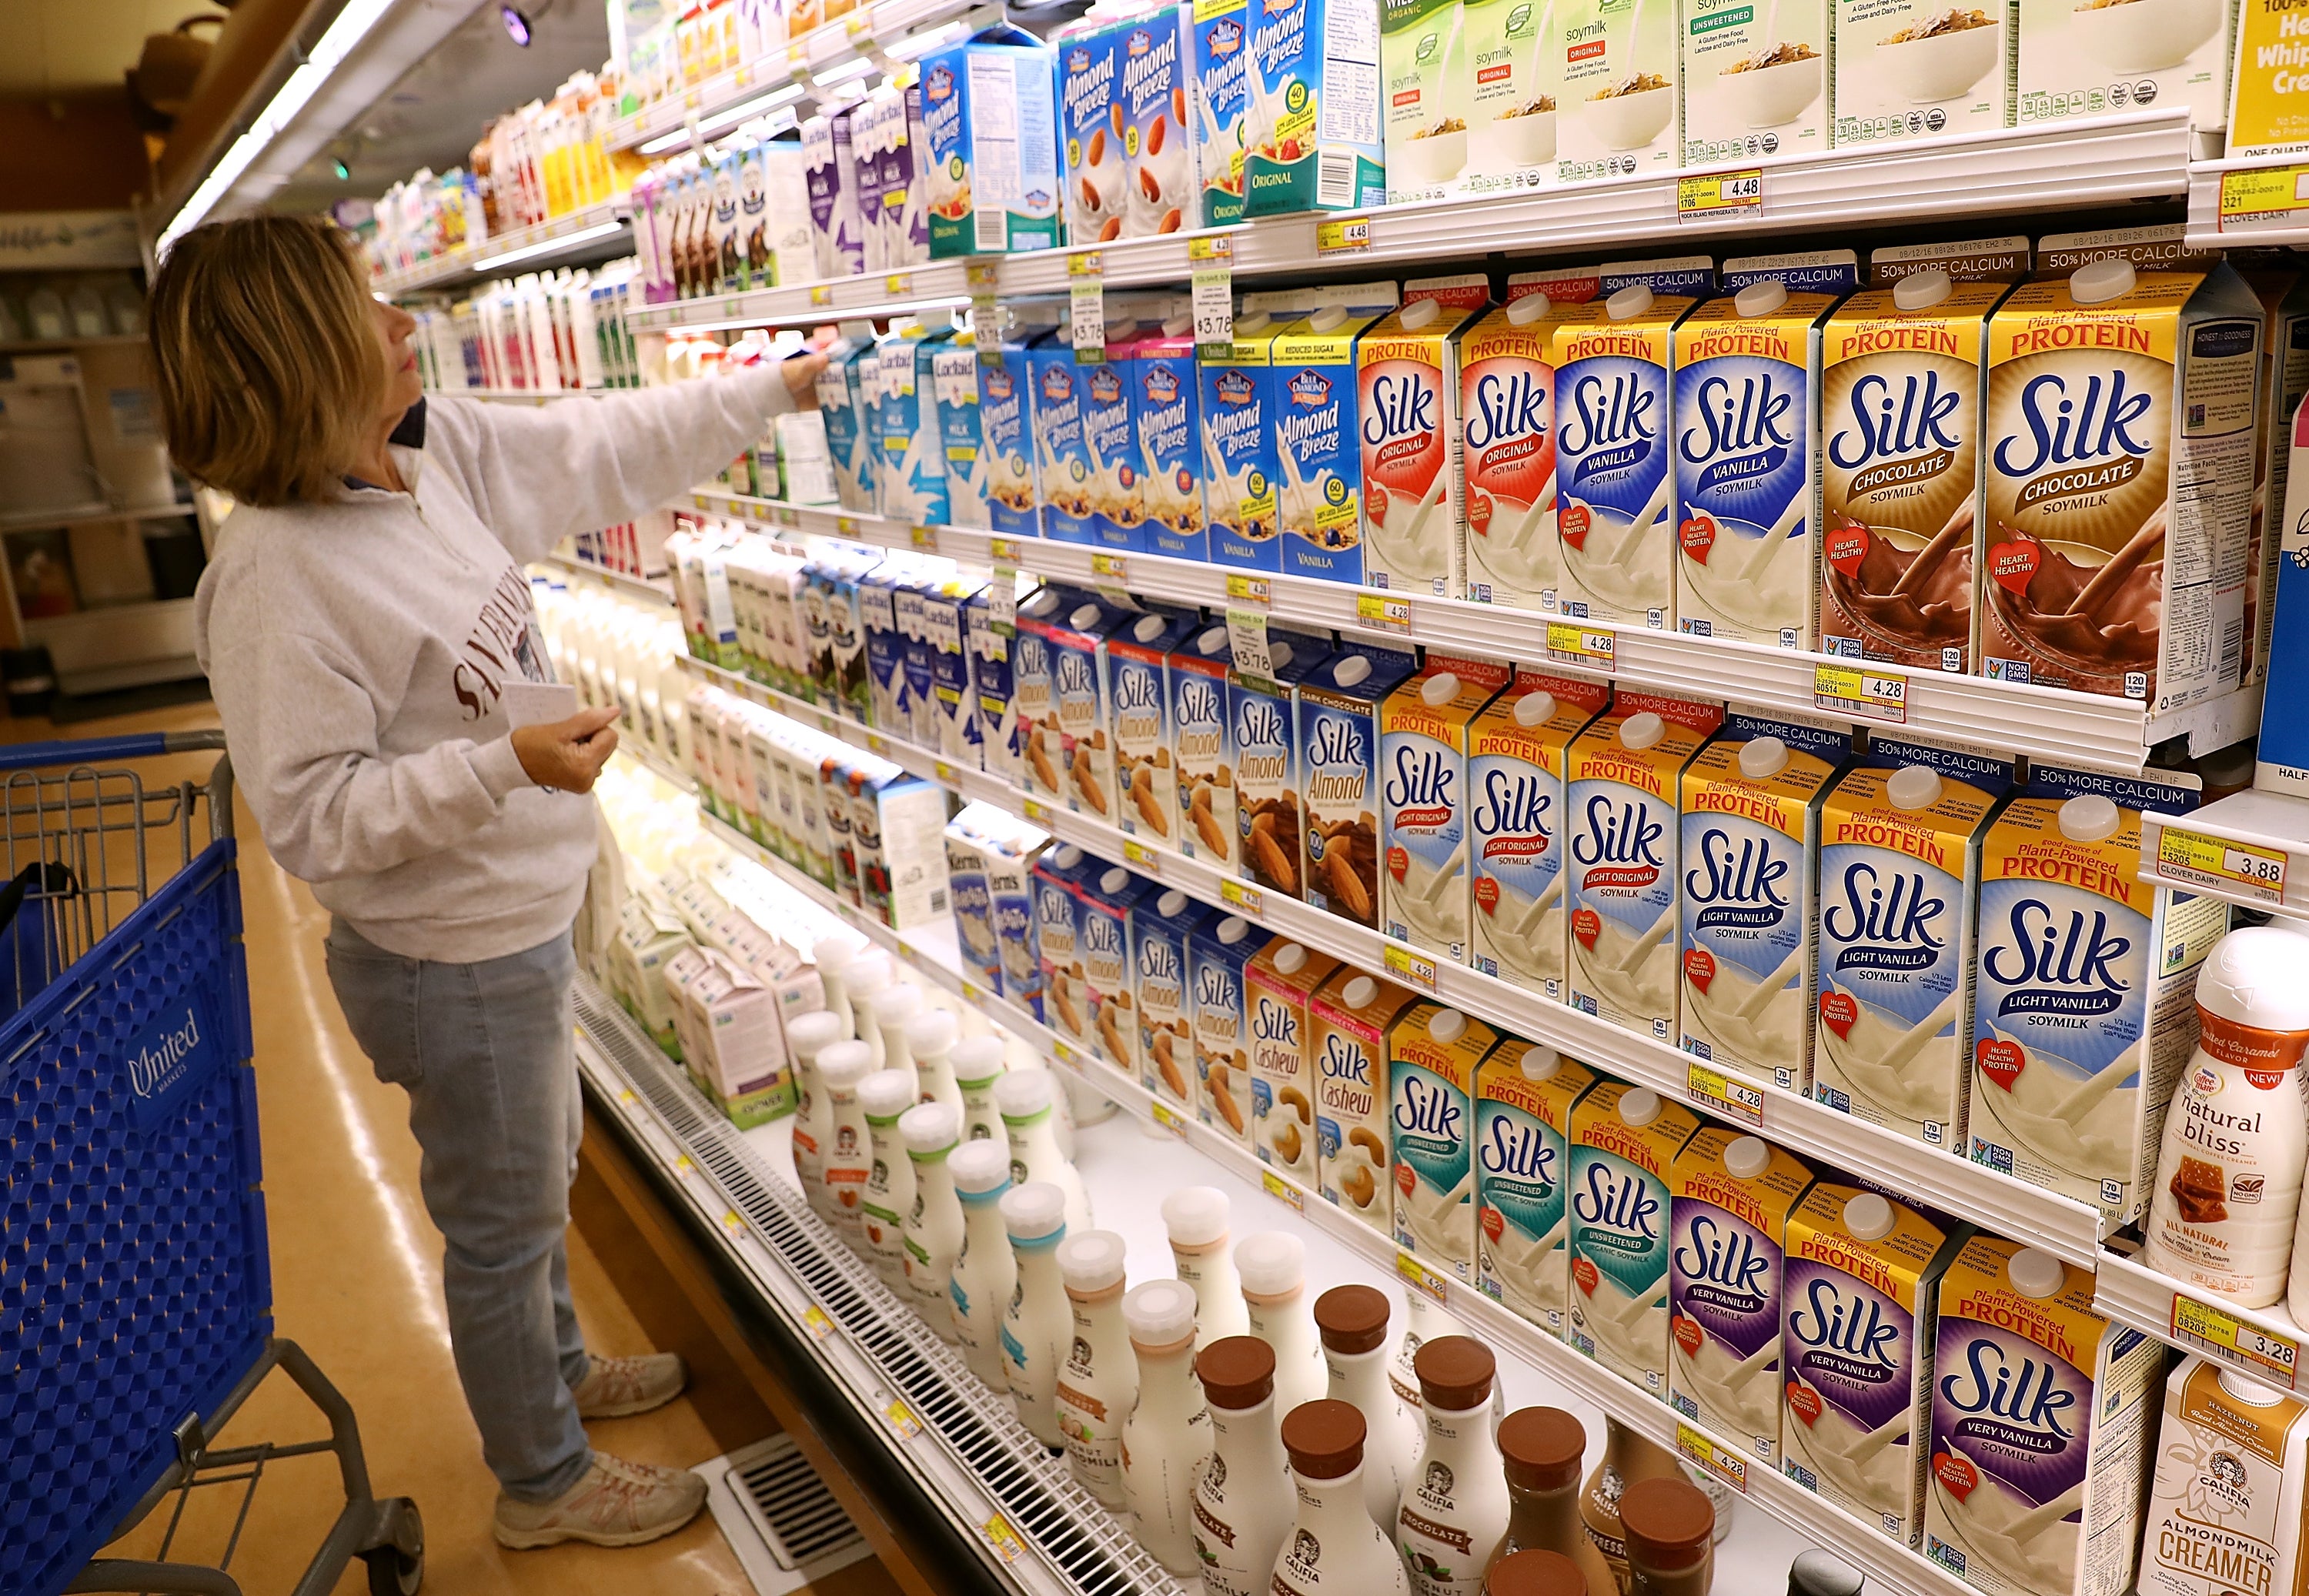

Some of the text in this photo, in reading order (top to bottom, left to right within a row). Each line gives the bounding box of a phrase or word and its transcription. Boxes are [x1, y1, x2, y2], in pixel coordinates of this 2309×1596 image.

[1388, 5, 1421, 21] ORGANIC
[1693, 11, 1749, 31] UNSWEETENED
[1848, 13, 1867, 23] Lactose
[1882, 7, 1896, 17] Dairy
[1566, 19, 1606, 41] soymilk
[1570, 45, 1601, 58] ORIGINAL
[1695, 45, 1712, 54] Lactose
[1723, 40, 1736, 48] Dairy
[1733, 179, 1757, 195] 4.48
[2224, 197, 2241, 209] 321
[1198, 315, 1232, 334] $3.78
[1701, 326, 1779, 339] Plant-Powered
[2028, 312, 2137, 329] Plant-Powered
[1285, 346, 1309, 354] REDUCED
[1470, 339, 1543, 361] PROTEIN
[1567, 339, 1652, 360] PROTEIN
[1689, 335, 1788, 361] PROTEIN
[1840, 329, 1958, 358] PROTEIN
[2011, 323, 2150, 356] PROTEIN
[1366, 344, 1432, 362] PROTEIN
[1364, 373, 1434, 444] Silk
[1466, 372, 1548, 449] Silk
[1559, 372, 1656, 456] Silk
[1680, 372, 1794, 463] Silk
[1829, 370, 1963, 469] Silk
[1283, 400, 1338, 448] Almond
[1993, 370, 2154, 477] Silk
[1301, 429, 1338, 462] Breeze
[1382, 439, 1424, 460] ORIGINAL
[1486, 442, 1534, 464] ORIGINAL
[1588, 449, 1635, 471] VANILLA
[1712, 456, 1768, 480] VANILLA
[1854, 454, 1945, 492] CHOCOLATE
[1589, 469, 1630, 486] SOYMILK
[1716, 478, 1763, 496] SOYMILK
[2024, 460, 2134, 502] CHOCOLATE
[1870, 485, 1925, 504] SOYMILK
[2043, 494, 2108, 516] SOYMILK
[1995, 563, 2033, 576] HEALTHY
[2000, 553, 2028, 566] HEART
[1591, 637, 1612, 650] 4.28
[1057, 653, 1091, 693] Silk
[1117, 666, 1157, 710] Silk
[1817, 684, 1837, 693] 60514
[1873, 680, 1901, 697] 4.28
[1177, 679, 1218, 725] Silk
[1302, 692, 1370, 715] DARK CHOCOLATE
[1237, 699, 1284, 749] Silk
[1736, 718, 1840, 746] 50% MORE CALCIUM
[1309, 719, 1363, 766] Silk
[1479, 738, 1549, 768] PROTEIN
[1237, 749, 1286, 780] Almond
[1878, 743, 2000, 775] 50% MORE CALCIUM
[1308, 769, 1366, 801] Almond
[1387, 745, 1455, 807] Silk
[1580, 762, 1661, 795] PROTEIN
[2040, 770, 2184, 803] 50% MORE CALCIUM
[2279, 768, 2308, 780] HALF
[1474, 770, 1552, 836] Silk
[1695, 793, 1786, 831] PROTEIN
[2023, 804, 2057, 814] ARTIFICIAL
[1572, 795, 1664, 866] Silk
[1851, 812, 1936, 840] Plant-Powered
[1999, 819, 2042, 830] SWEETENERS
[2003, 813, 2033, 822] FLAVORS
[1837, 824, 1944, 867] PROTEIN
[2042, 839, 2063, 848] good
[2065, 843, 2090, 853] source
[1686, 829, 1789, 907] Silk
[2018, 845, 2118, 875] Plant-Powered
[2241, 858, 2280, 880] 3.88
[1587, 870, 1653, 883] LIGHT ORIGINAL
[2002, 857, 2130, 903] PROTEIN
[2161, 866, 2220, 885] CLOVER DAIRY
[1599, 887, 1639, 898] SOYMILK
[1824, 863, 1946, 948] Silk
[1703, 912, 1774, 923] LIGHT VANILLA
[1716, 929, 1760, 940] SOYMILK
[1984, 899, 2130, 991] Silk
[1843, 952, 1927, 965] LIGHT VANILLA
[1196, 967, 1236, 1011] Silk
[1859, 970, 1910, 983] SOYMILK
[2009, 996, 2109, 1009] LIGHT VANILLA
[1253, 999, 1298, 1047] Silk
[2027, 1015, 2089, 1030] SOYMILK
[129, 1007, 199, 1099] United
[1320, 1034, 1369, 1085] Silk
[1987, 1053, 2015, 1063] HEALTHY
[1990, 1047, 2012, 1056] HEART
[2217, 1050, 2248, 1063] FLAVOR
[2228, 1040, 2280, 1057] Caramel
[1399, 1048, 1459, 1084] PROTEIN
[1983, 1060, 2018, 1073] PROTEIN
[2250, 1074, 2280, 1083] NEW!
[1320, 1079, 1372, 1116] Cashew
[1395, 1077, 1461, 1141] Silk
[1486, 1084, 1554, 1125] PROTEIN
[1736, 1088, 1760, 1107] 4.28
[2182, 1095, 2261, 1133] natural
[2184, 1117, 2241, 1154] bliss
[1481, 1115, 1556, 1185] Silk
[1582, 1130, 1659, 1174] PROTEIN
[1993, 1147, 2011, 1157] NON
[1993, 1154, 2011, 1164] GMO
[1495, 1180, 1541, 1195] UNSWEETENED
[1573, 1163, 1659, 1238] Silk
[1684, 1181, 1768, 1231] PROTEIN
[1589, 1231, 1641, 1250] UNSWEETENED
[2167, 1219, 2229, 1250] ALL NATURAL
[1674, 1215, 1769, 1298] Silk
[1801, 1241, 1897, 1298] PROTEIN
[1692, 1288, 1754, 1309] VERY VANILLA
[1703, 1304, 1743, 1323] SOYMILK
[1789, 1278, 1900, 1367] Silk
[1973, 1290, 2065, 1335] Plant-Powered
[1960, 1300, 2074, 1363] PROTEIN
[2178, 1317, 2206, 1335] 08205
[2255, 1337, 2293, 1363] 3.28
[1811, 1355, 1881, 1380] VERY VANILLA
[1823, 1372, 1869, 1393] SOYMILK
[1940, 1339, 2075, 1438] Silk
[2208, 1401, 2259, 1431] HAZELNUT
[2217, 1415, 2249, 1435] MADE WITH
[1967, 1422, 2052, 1449] VERY VANILLA
[2190, 1410, 2274, 1457] Real Almond Cream
[1722, 1454, 1743, 1476] 4.28
[1981, 1442, 2037, 1464] SOYMILK
[1416, 1488, 1455, 1511] CALIFIA
[2200, 1477, 2251, 1509] CALIFIA
[1403, 1512, 1463, 1542] CHOCOLATE
[2162, 1519, 2275, 1567] ALMONDMILK
[1285, 1557, 1320, 1584] CALIFIA
[2159, 1531, 2271, 1596] CREAMER
